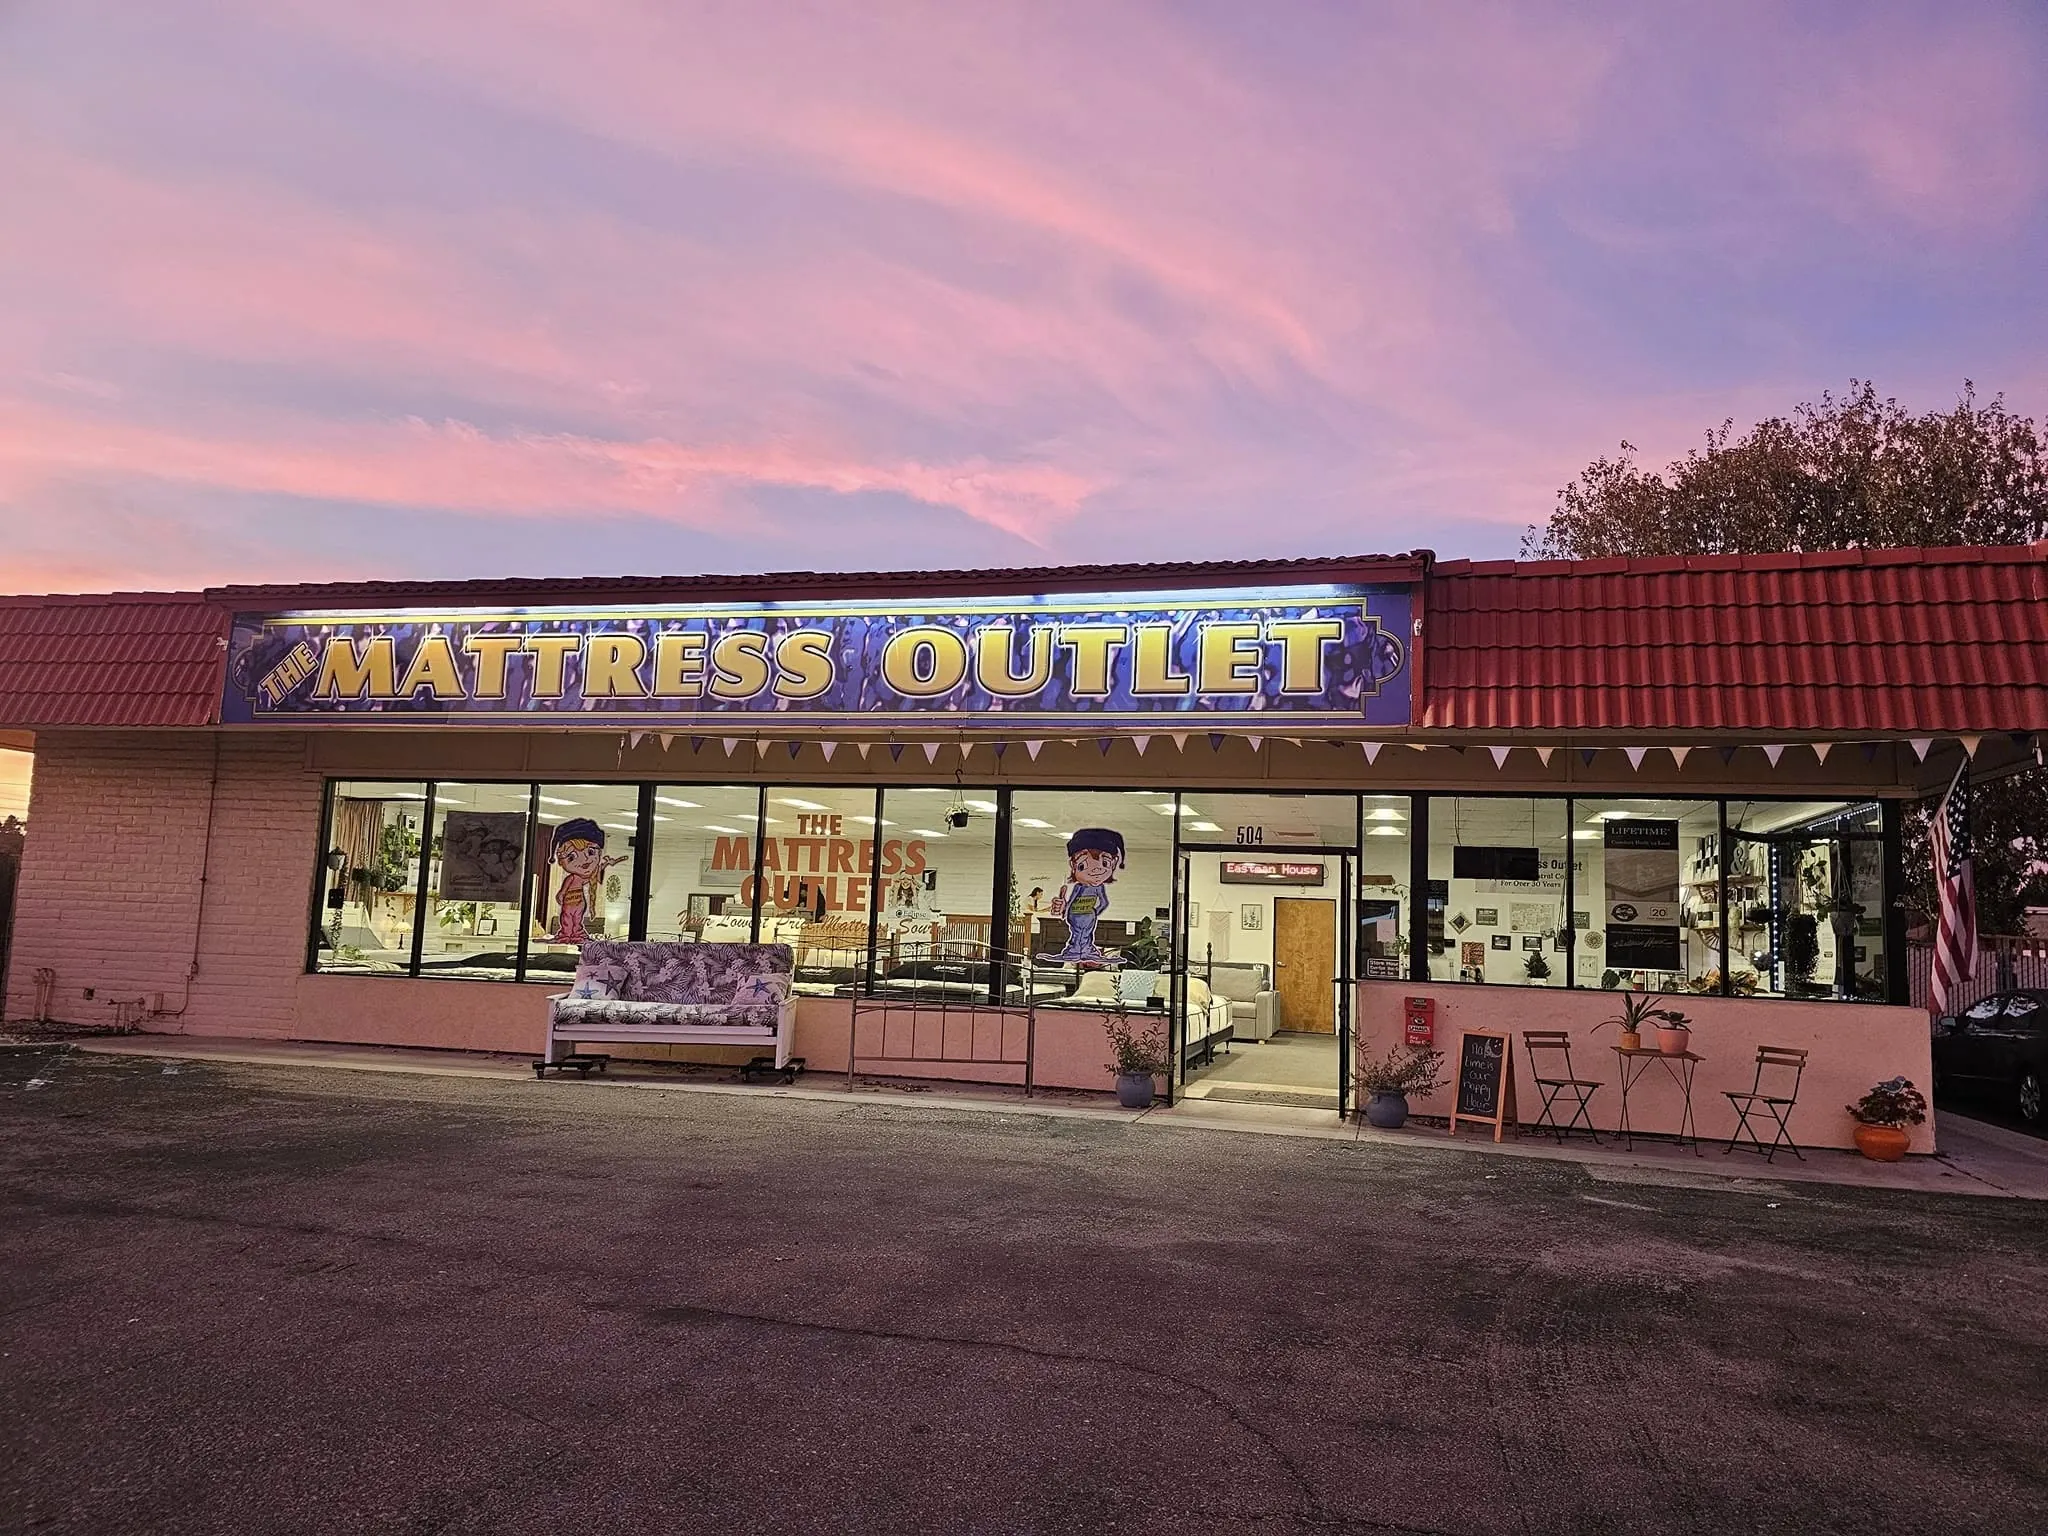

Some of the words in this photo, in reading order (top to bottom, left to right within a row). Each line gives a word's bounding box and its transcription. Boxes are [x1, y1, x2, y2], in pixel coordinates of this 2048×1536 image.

[312, 631, 834, 700] MATTRESS
[882, 621, 1342, 696] OUTLET
[260, 641, 319, 704] THE
[797, 814, 843, 835] THE
[1611, 827, 1669, 836] LIFETIME
[1237, 826, 1263, 845] 504
[711, 836, 926, 874] MATTRESS
[1551, 859, 1583, 871] Outet
[1226, 863, 1276, 874] Eastman
[1281, 864, 1318, 875] House
[741, 875, 891, 912] OUTLET
[677, 910, 711, 928] Your
[716, 911, 769, 928] Lowet
[818, 914, 889, 933] Mattrss
[904, 910, 927, 919] Eclipse
[1652, 908, 1666, 917] 20
